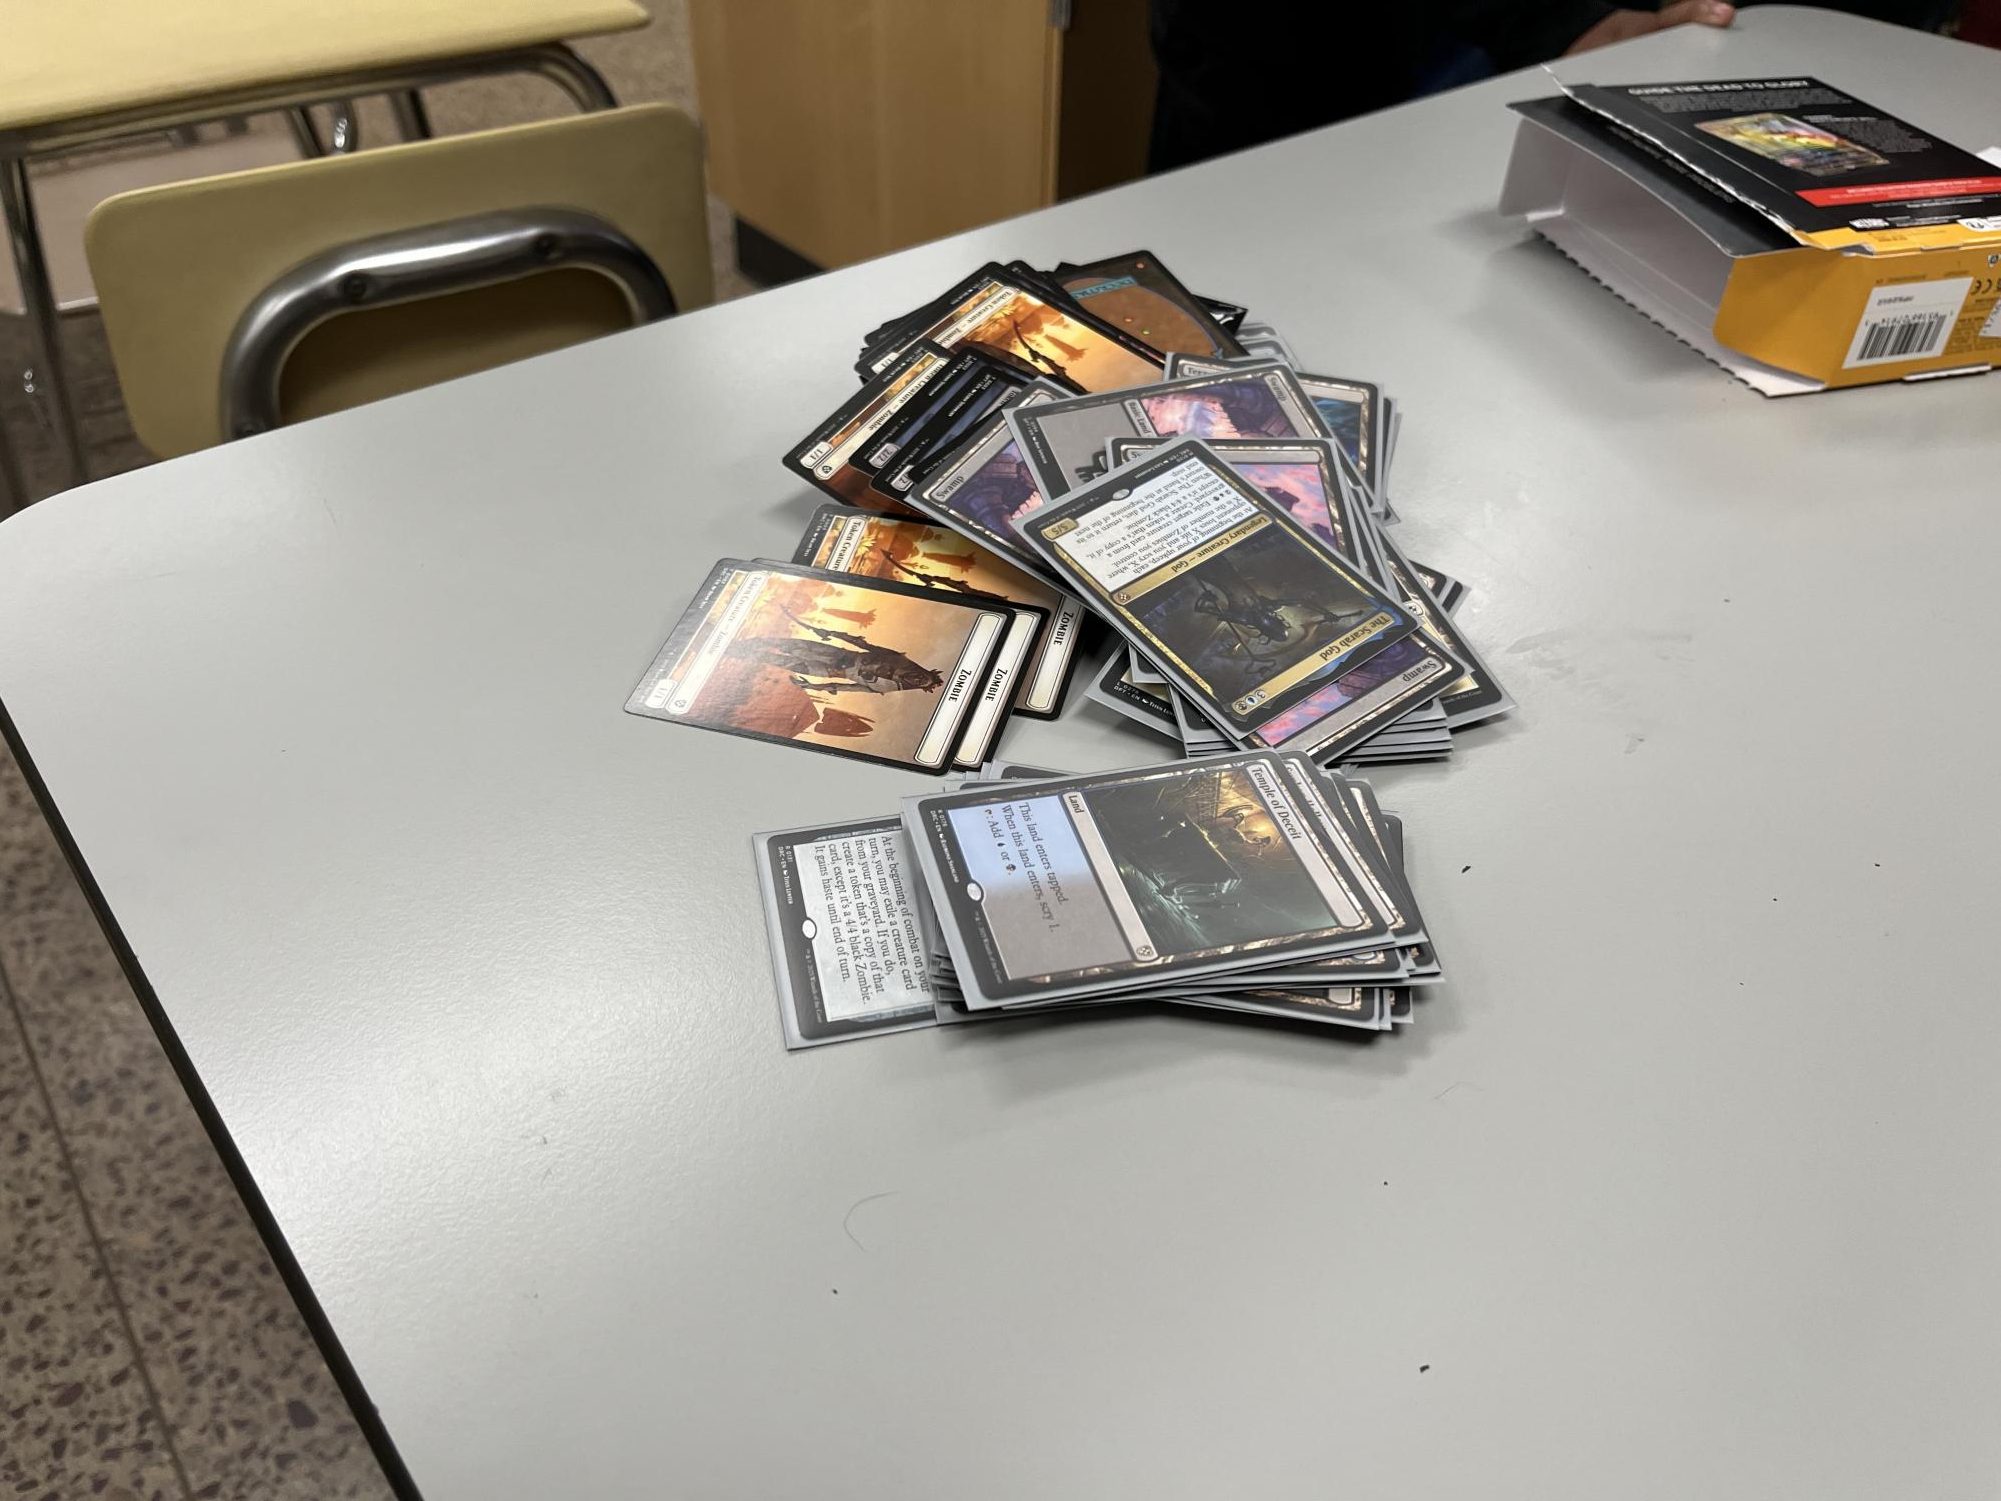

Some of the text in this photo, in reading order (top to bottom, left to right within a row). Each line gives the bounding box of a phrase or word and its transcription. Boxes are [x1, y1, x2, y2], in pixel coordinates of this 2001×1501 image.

[866, 408, 894, 432] Zombie
[1136, 417, 1151, 434] Land
[1179, 465, 1205, 481] owner's
[1189, 470, 1211, 484] When
[936, 475, 965, 499] Swamp
[1161, 478, 1181, 491] hand
[1175, 481, 1191, 491] The
[1153, 488, 1178, 503] Scarab
[1109, 496, 1145, 518] beginning
[1137, 500, 1156, 512] God
[1151, 504, 1172, 517] black
[1171, 508, 1193, 522] target
[1049, 522, 1069, 535] 5/5
[1073, 525, 1091, 537] next
[1099, 517, 1123, 531] return
[1144, 515, 1166, 529] token
[1144, 519, 1174, 537] creature
[1125, 526, 1147, 539] that's
[1129, 534, 1147, 546] card
[1150, 528, 1182, 547] Zombies
[1165, 537, 1181, 547] and
[829, 520, 863, 571] Token Creature
[1102, 538, 1122, 550] copy
[1112, 543, 1131, 555] from
[1136, 543, 1152, 553] you
[1151, 543, 1167, 554] you
[1169, 515, 1269, 573] Legendary Creature God
[1110, 550, 1140, 568] control.
[1131, 562, 1151, 574] each
[1105, 565, 1129, 579] where
[1052, 610, 1074, 646] ZOMBIE
[1317, 614, 1390, 662] The Scarab God
[1398, 659, 1439, 684] Swamp
[947, 668, 972, 703] ZOMBIE
[984, 668, 1008, 702] ZOMBIE
[1248, 767, 1279, 798] Temple
[1067, 794, 1084, 813] Land
[1269, 799, 1286, 810] of
[1276, 811, 1305, 839] Deceit
[826, 843, 842, 864] card,
[841, 841, 855, 866] create
[866, 837, 880, 858] turn,
[999, 851, 1010, 861] or
[1016, 802, 1071, 905] This land enters tapped.
[871, 859, 883, 875] you
[998, 804, 1062, 932] When this land enters, scry 1.
[831, 865, 848, 894] except
[849, 874, 864, 900] token
[875, 877, 889, 896] may
[839, 895, 852, 909] it's
[854, 839, 898, 975] from your graveyard. If you do,
[883, 897, 898, 918] exile
[814, 845, 852, 982] It gains haste until end of turn.
[855, 901, 871, 926] that's
[880, 835, 931, 994] At the beginning of combat on your
[844, 917, 858, 933] 4/4
[848, 935, 865, 961] black
[861, 935, 877, 959] copy
[890, 927, 909, 966] creature
[868, 960, 882, 972] of
[854, 961, 874, 1005] Zombie.
[872, 972, 887, 993] that
[901, 967, 916, 990] card
